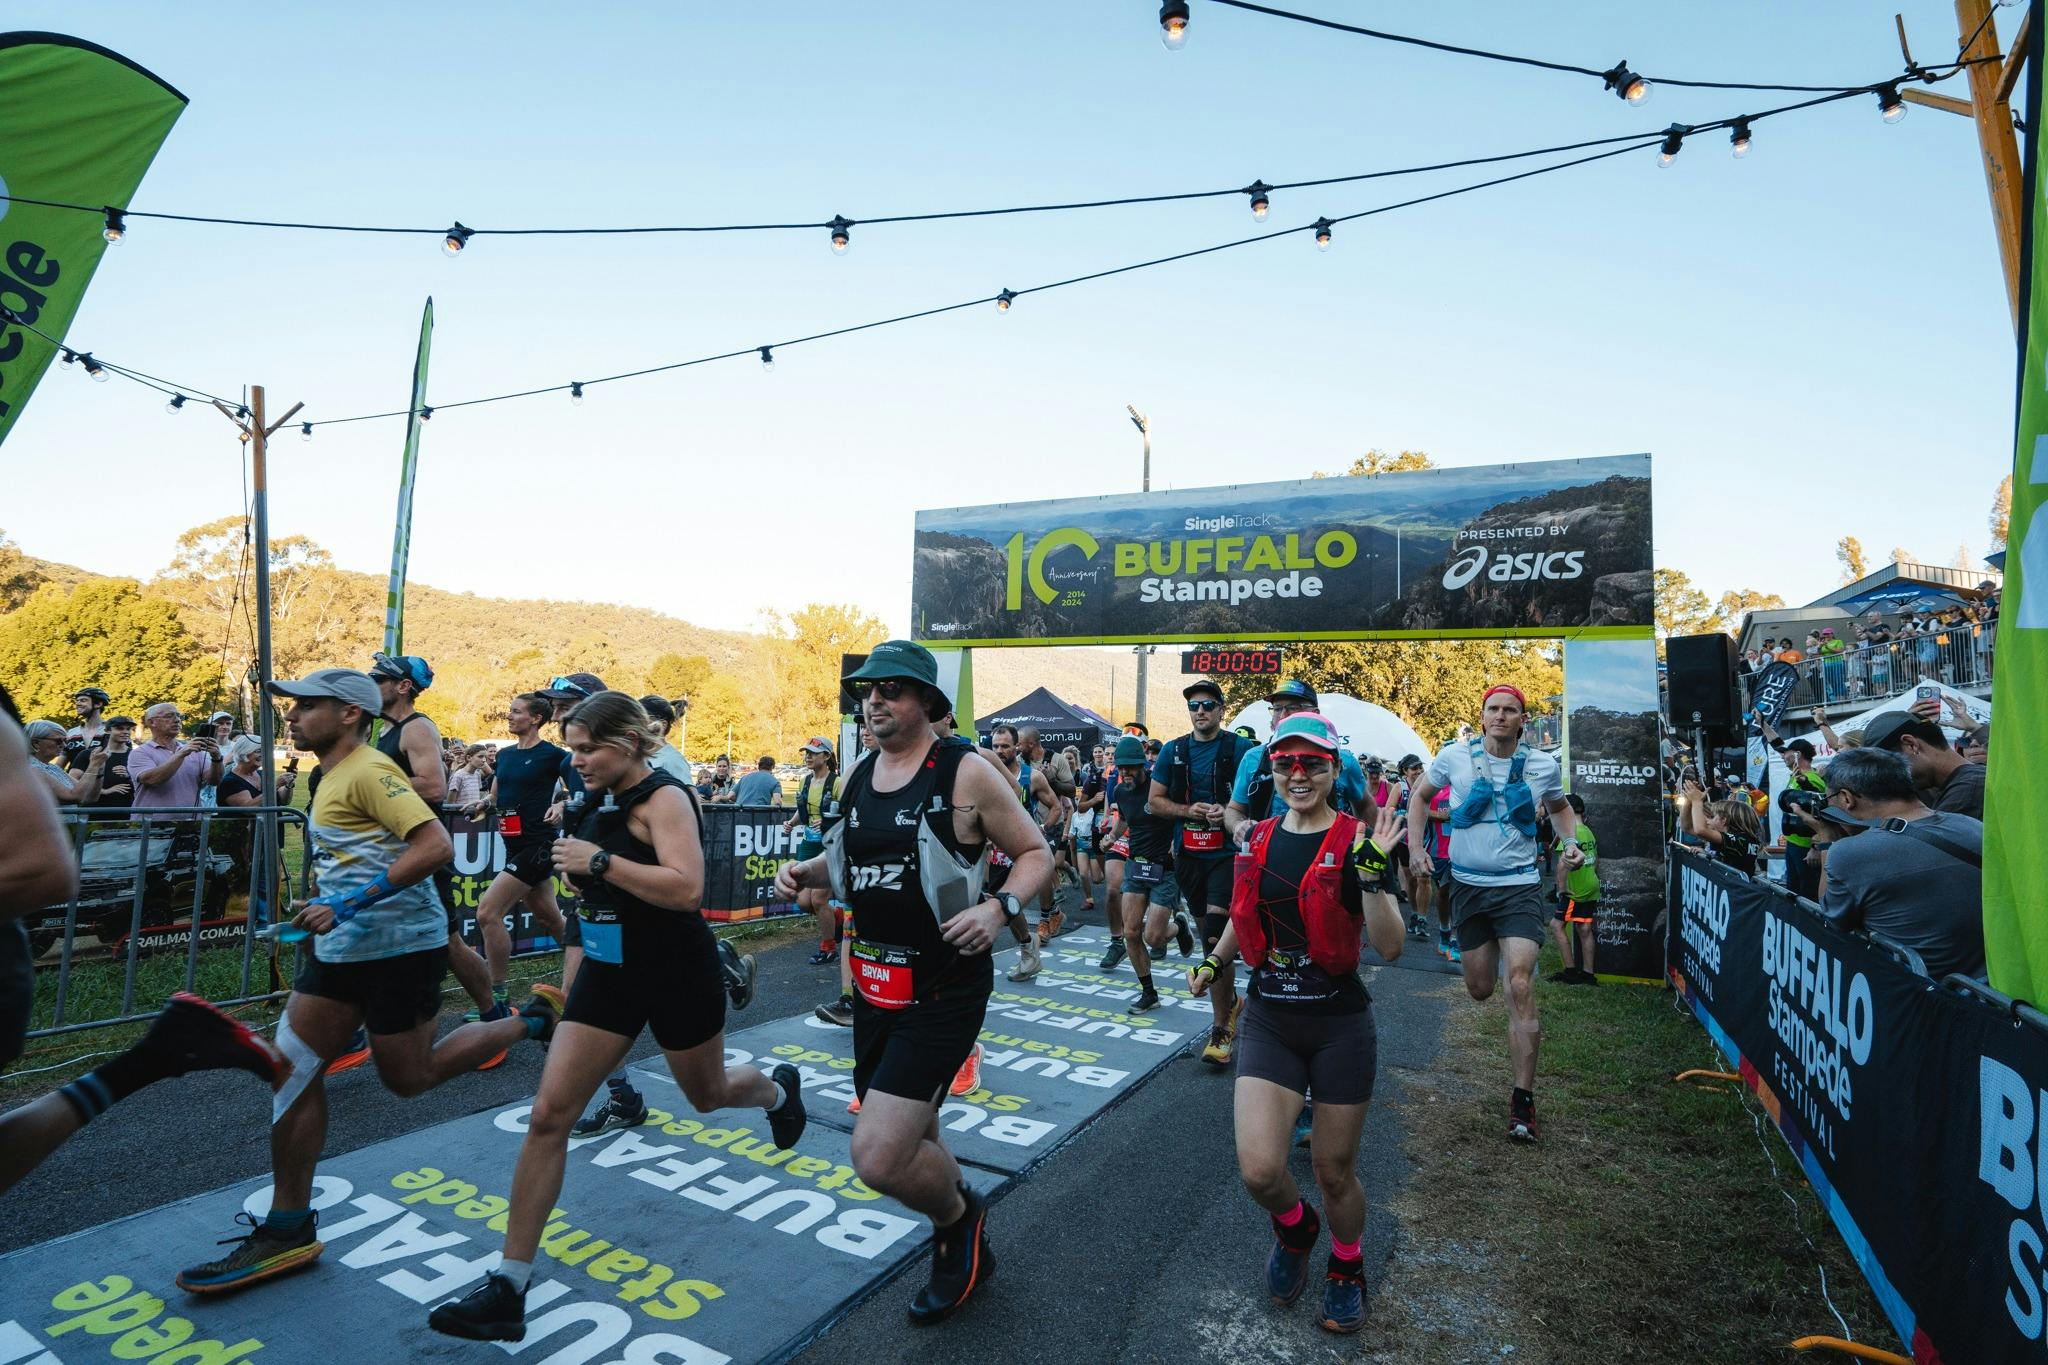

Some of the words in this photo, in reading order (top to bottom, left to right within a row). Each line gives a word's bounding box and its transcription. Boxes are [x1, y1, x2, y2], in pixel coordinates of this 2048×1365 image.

[1184, 513, 1271, 532] SingleTrack
[1460, 526, 1545, 540] PRESENTED
[1550, 525, 1569, 536] BY
[1114, 530, 1358, 577] BUFFALO
[1048, 567, 1099, 584] Anniversary
[1066, 591, 1086, 599] 2014
[1140, 571, 1324, 606] Stampede
[1192, 652, 1279, 673] 18:00:05
[1576, 764, 1656, 778] BUFFALO
[1585, 775, 1646, 786] Stampede
[1681, 864, 1730, 941] BUFFALO
[1681, 905, 1721, 975] Stampede
[862, 963, 890, 983] BRYAN
[1684, 952, 1714, 1002] FESTIVAL
[1282, 984, 1299, 992] 266
[1762, 911, 1873, 1066] BUFFALO
[1768, 978, 1852, 1121] Stampede
[1775, 1051, 1836, 1162] FESTIVAL
